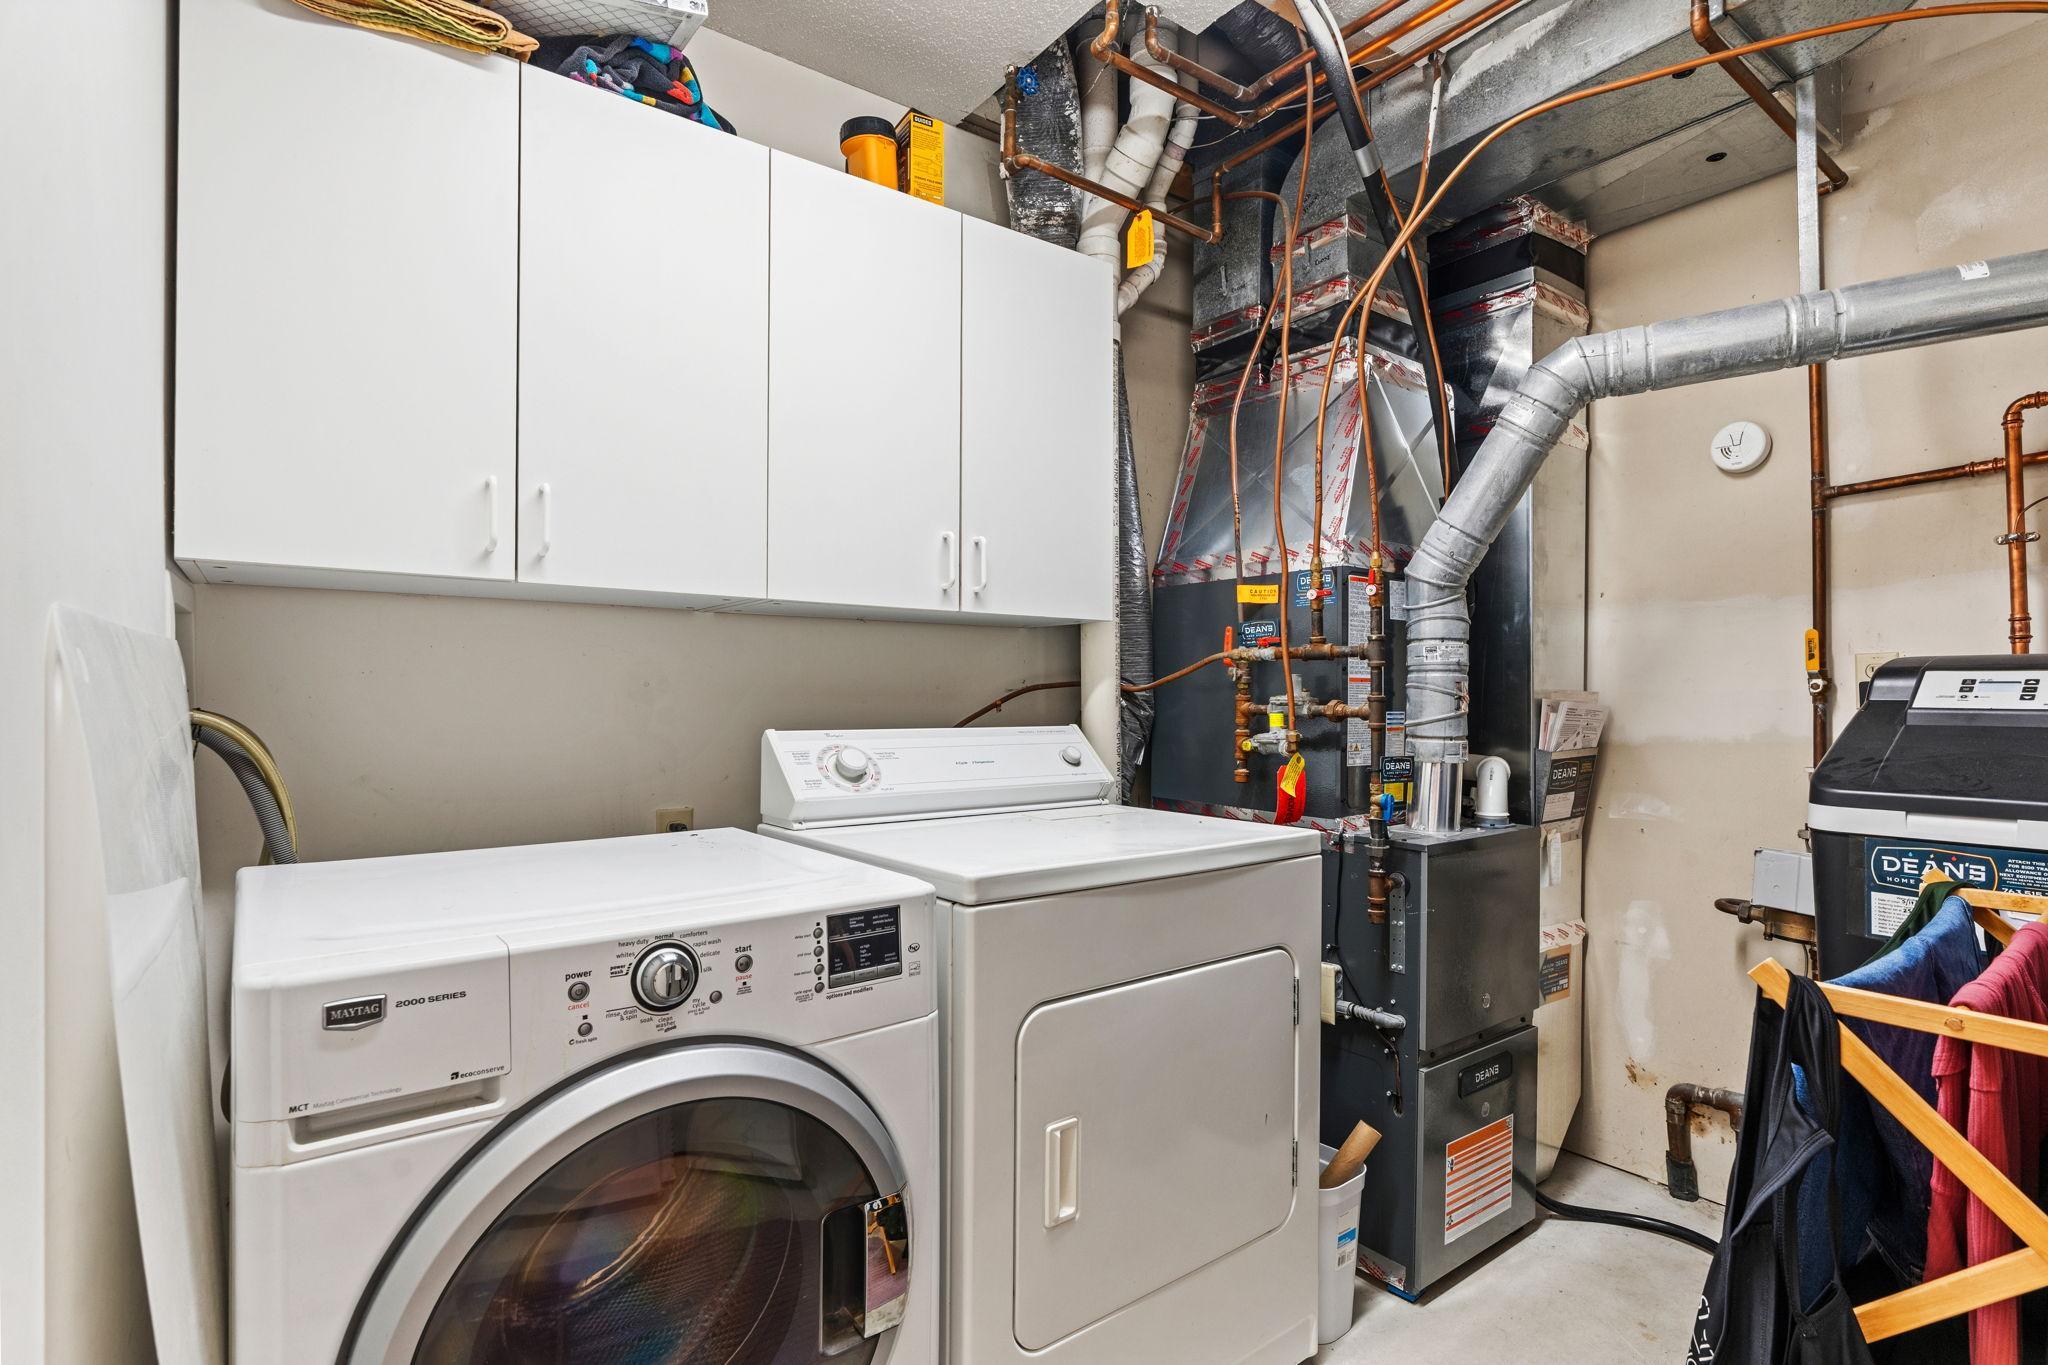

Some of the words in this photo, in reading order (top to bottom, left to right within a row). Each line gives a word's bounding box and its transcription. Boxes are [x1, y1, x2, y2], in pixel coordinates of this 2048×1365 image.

[2004, 868, 2042, 876] ALLOWANCE
[1887, 876, 1916, 885] HOME
[655, 932, 674, 940] normal
[680, 930, 708, 938] comforters
[700, 950, 720, 958] delicate
[735, 944, 752, 954] start
[565, 970, 592, 982] power
[736, 974, 752, 982] pause
[396, 997, 426, 1008] 2000
[428, 991, 467, 1003] SERIES
[826, 992, 843, 1000] options
[568, 1001, 590, 1011] cancel
[330, 1003, 379, 1020] MAYTAG
[460, 1065, 505, 1079] ecoconserve
[288, 1103, 310, 1114] MCT
[336, 1093, 370, 1104] Commercial
[371, 1088, 402, 1096] Technology
